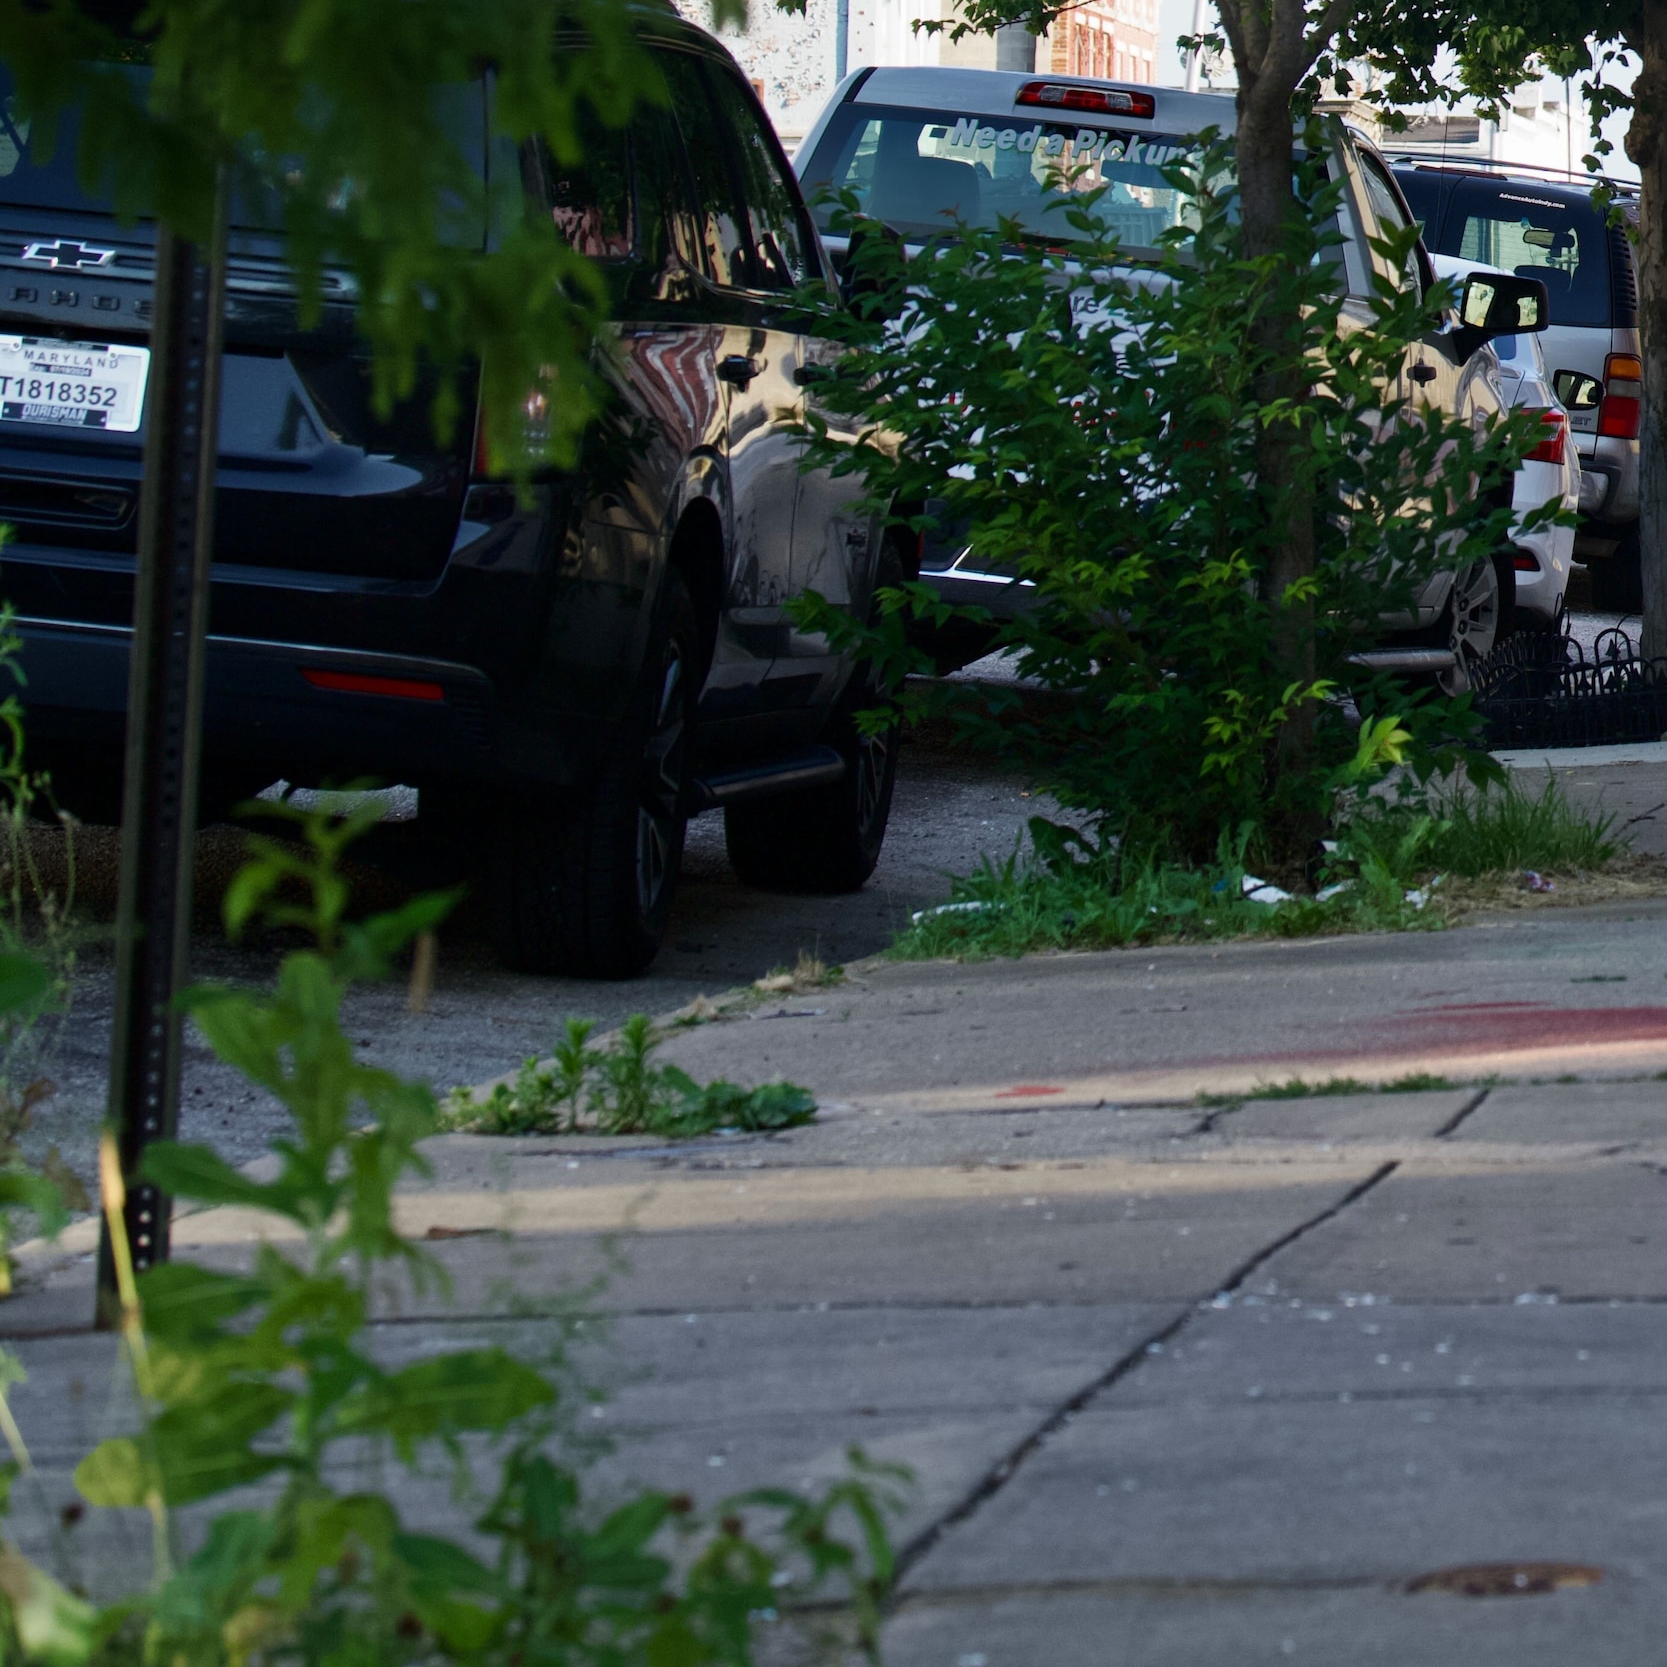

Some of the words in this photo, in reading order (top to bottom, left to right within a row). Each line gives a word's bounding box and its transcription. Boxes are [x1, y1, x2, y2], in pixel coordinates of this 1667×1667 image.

[951, 117, 1042, 154] Need
[1046, 133, 1065, 157] a
[24, 348, 119, 370] MARYLAND
[22, 404, 88, 422] OURISMAN
